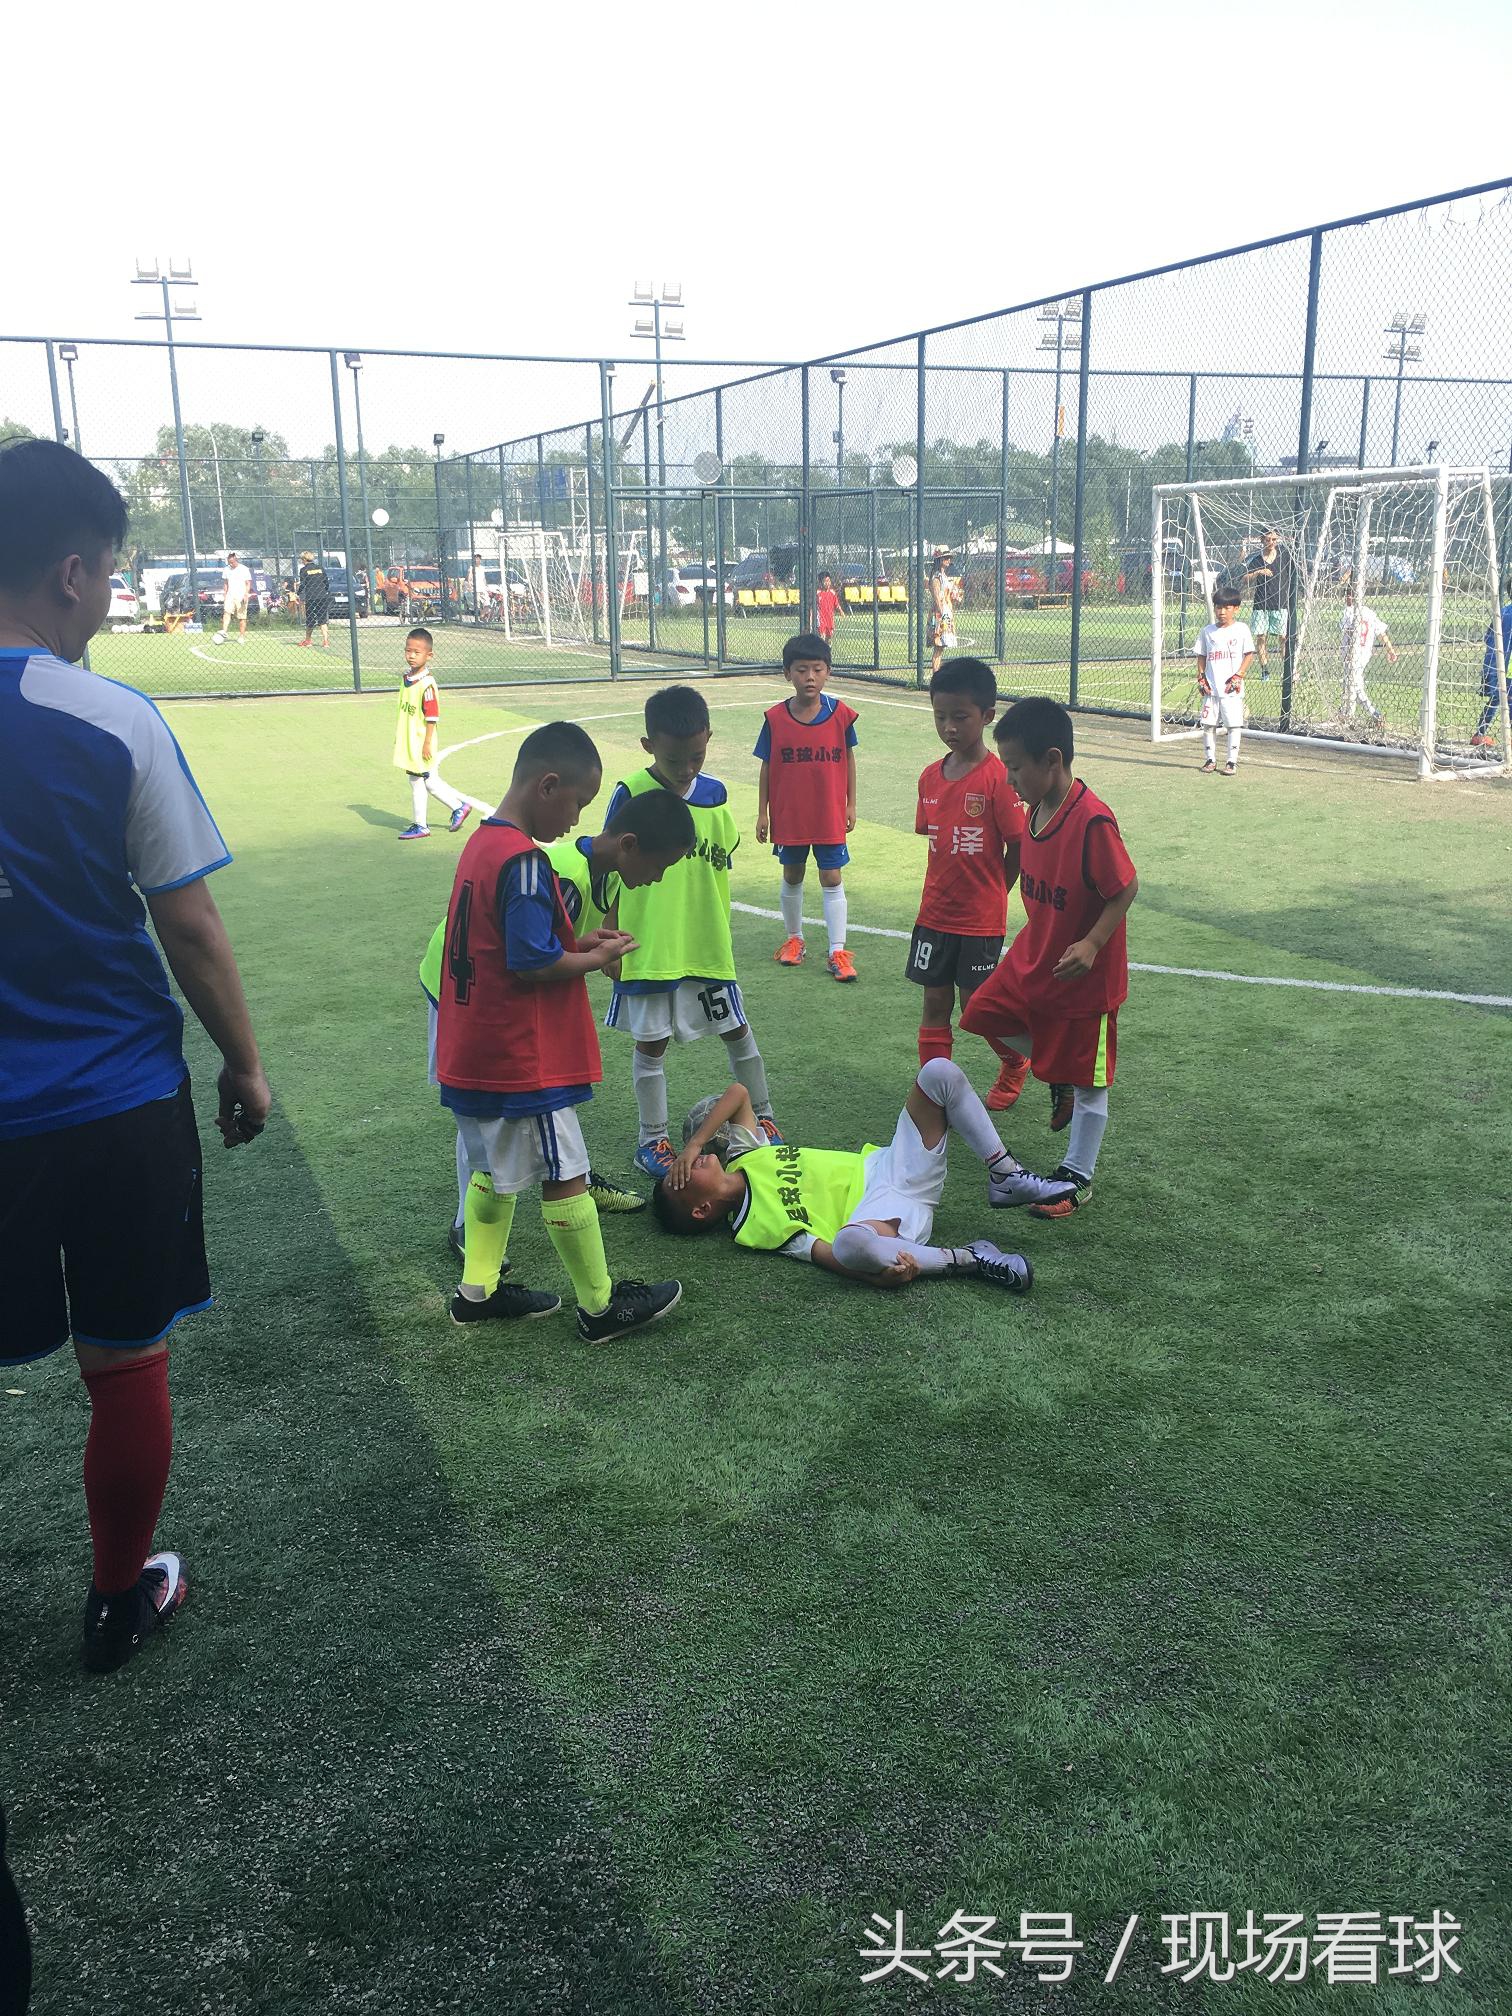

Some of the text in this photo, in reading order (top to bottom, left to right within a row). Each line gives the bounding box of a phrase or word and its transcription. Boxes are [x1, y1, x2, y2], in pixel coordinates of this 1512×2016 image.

[914, 939, 933, 970] 19
[971, 963, 995, 971] KELME
[697, 984, 730, 1021] 15
